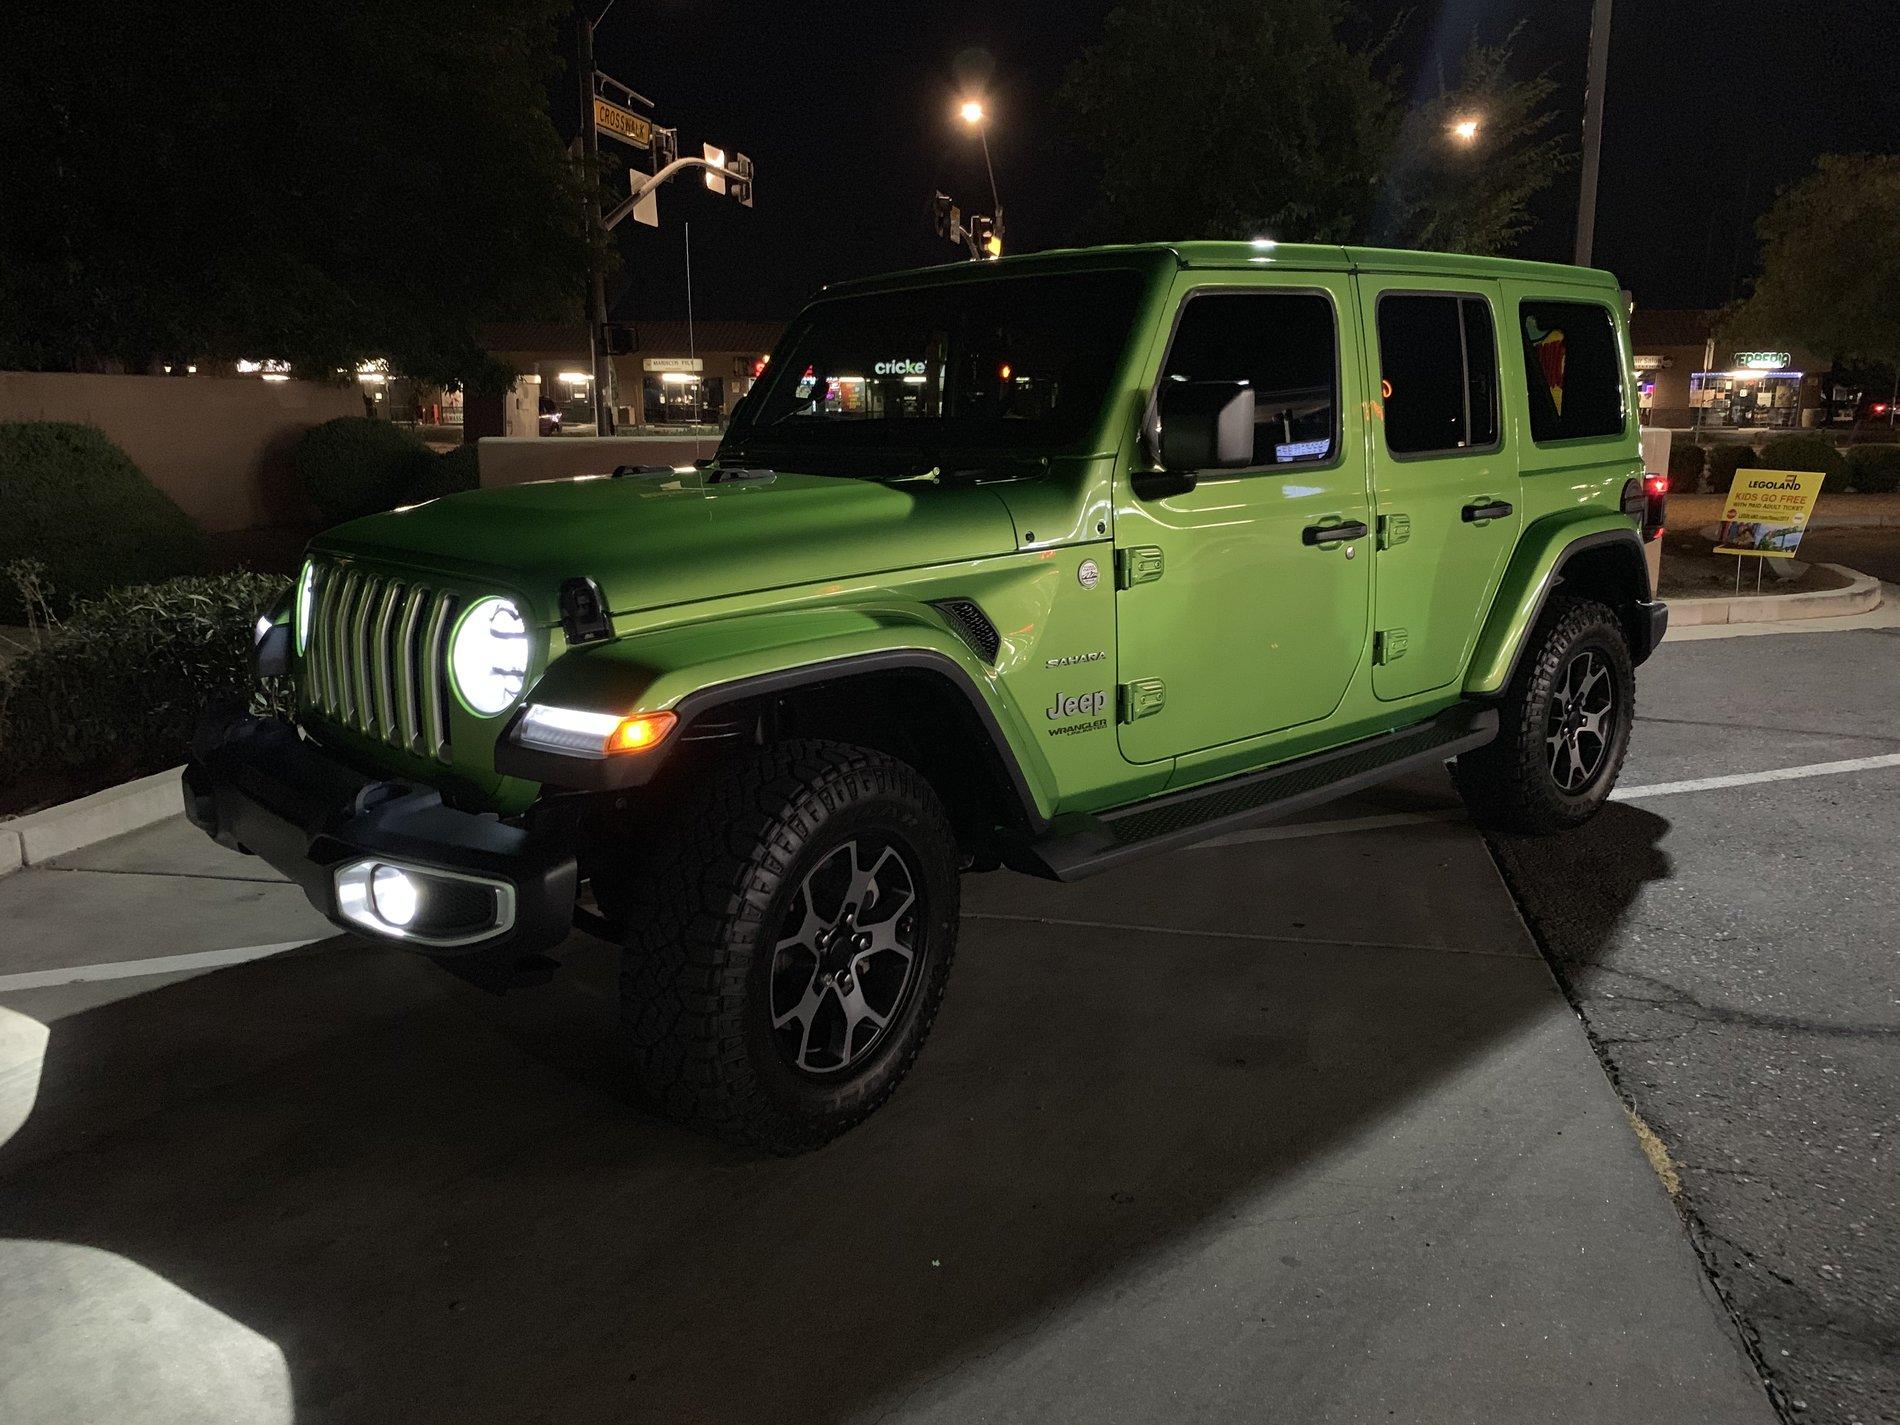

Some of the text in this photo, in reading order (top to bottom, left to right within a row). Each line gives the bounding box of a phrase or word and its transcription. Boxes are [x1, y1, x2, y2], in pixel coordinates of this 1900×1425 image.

[600, 107, 645, 138] CROSSWALK
[875, 358, 926, 375] cricke
[1748, 481, 1801, 491] LEGOLAND
[1735, 492, 1808, 505] KIDS GO FREE
[1046, 651, 1106, 669] SAHARA
[1046, 690, 1107, 720] Jeep
[1048, 718, 1108, 737] WRANGLER
